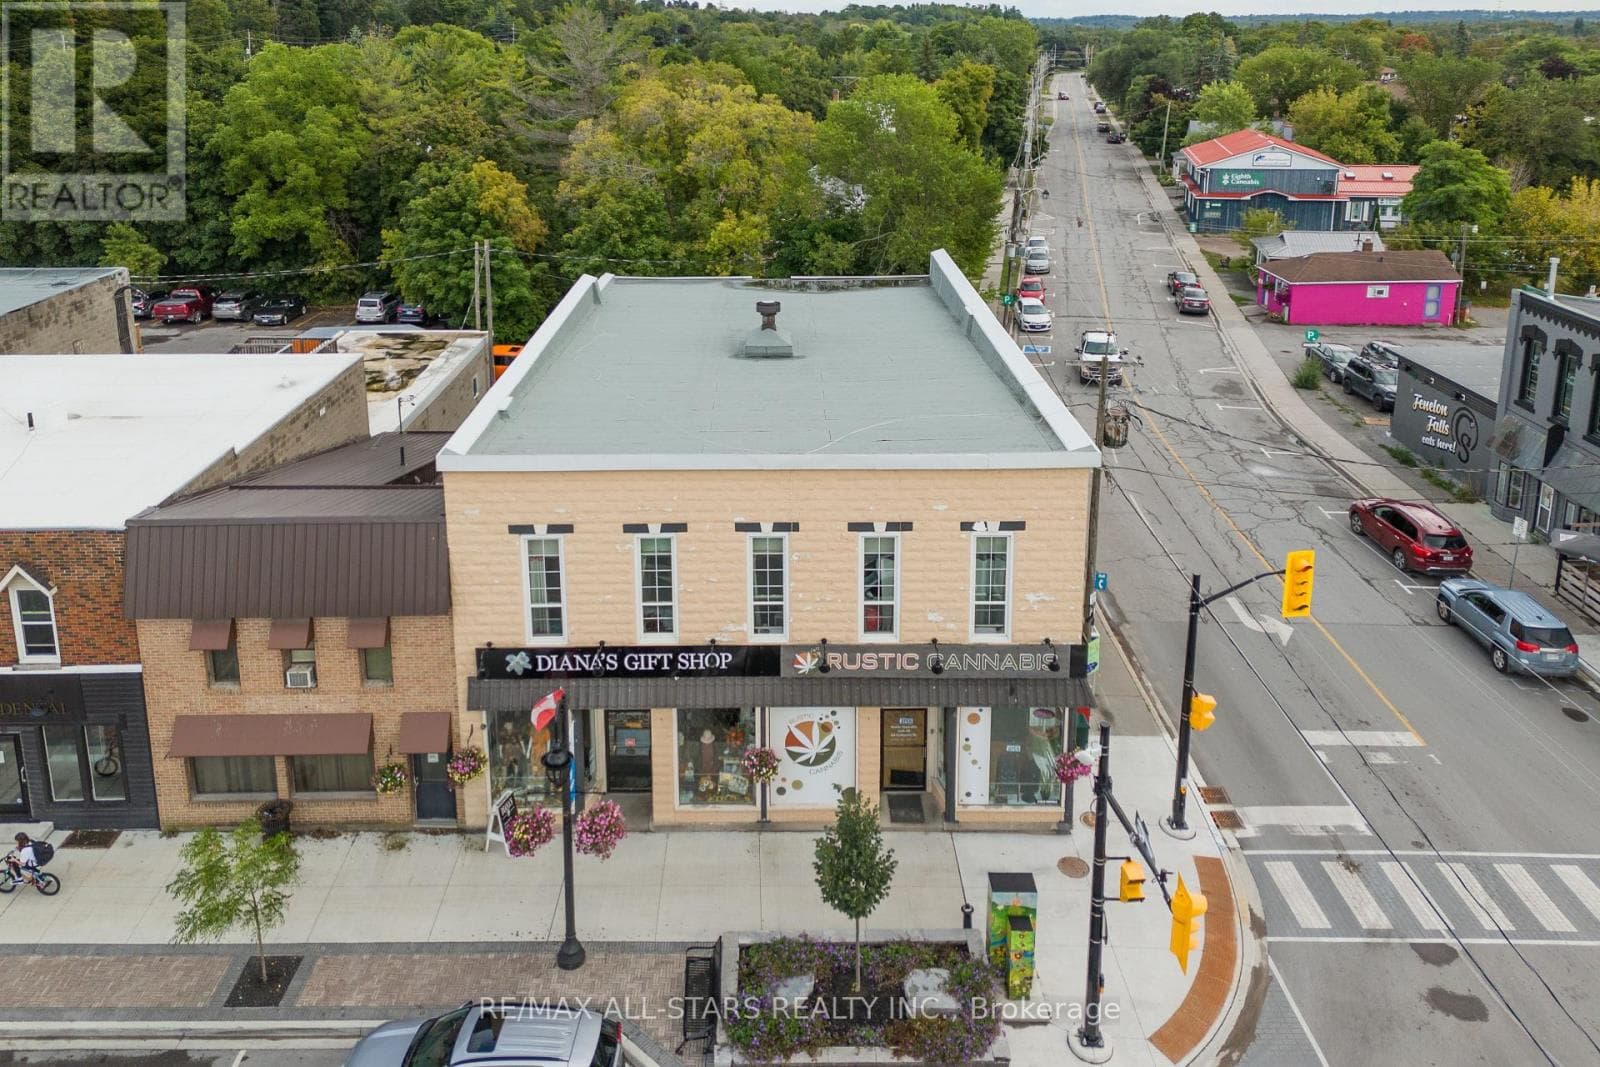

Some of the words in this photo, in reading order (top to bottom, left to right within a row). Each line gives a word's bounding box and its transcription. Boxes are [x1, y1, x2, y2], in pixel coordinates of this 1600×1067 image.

[1412, 393, 1448, 417] Fenelon
[1426, 415, 1450, 435] Falls
[1421, 435, 1436, 447] eats
[1436, 437, 1457, 454] here!
[535, 653, 618, 671] DIANA'S
[623, 653, 673, 670] GIFT
[677, 652, 733, 670] SHOP
[826, 652, 920, 670] RUSTIC
[926, 652, 1060, 671] CANNABIS
[0, 702, 72, 715] DENAL
